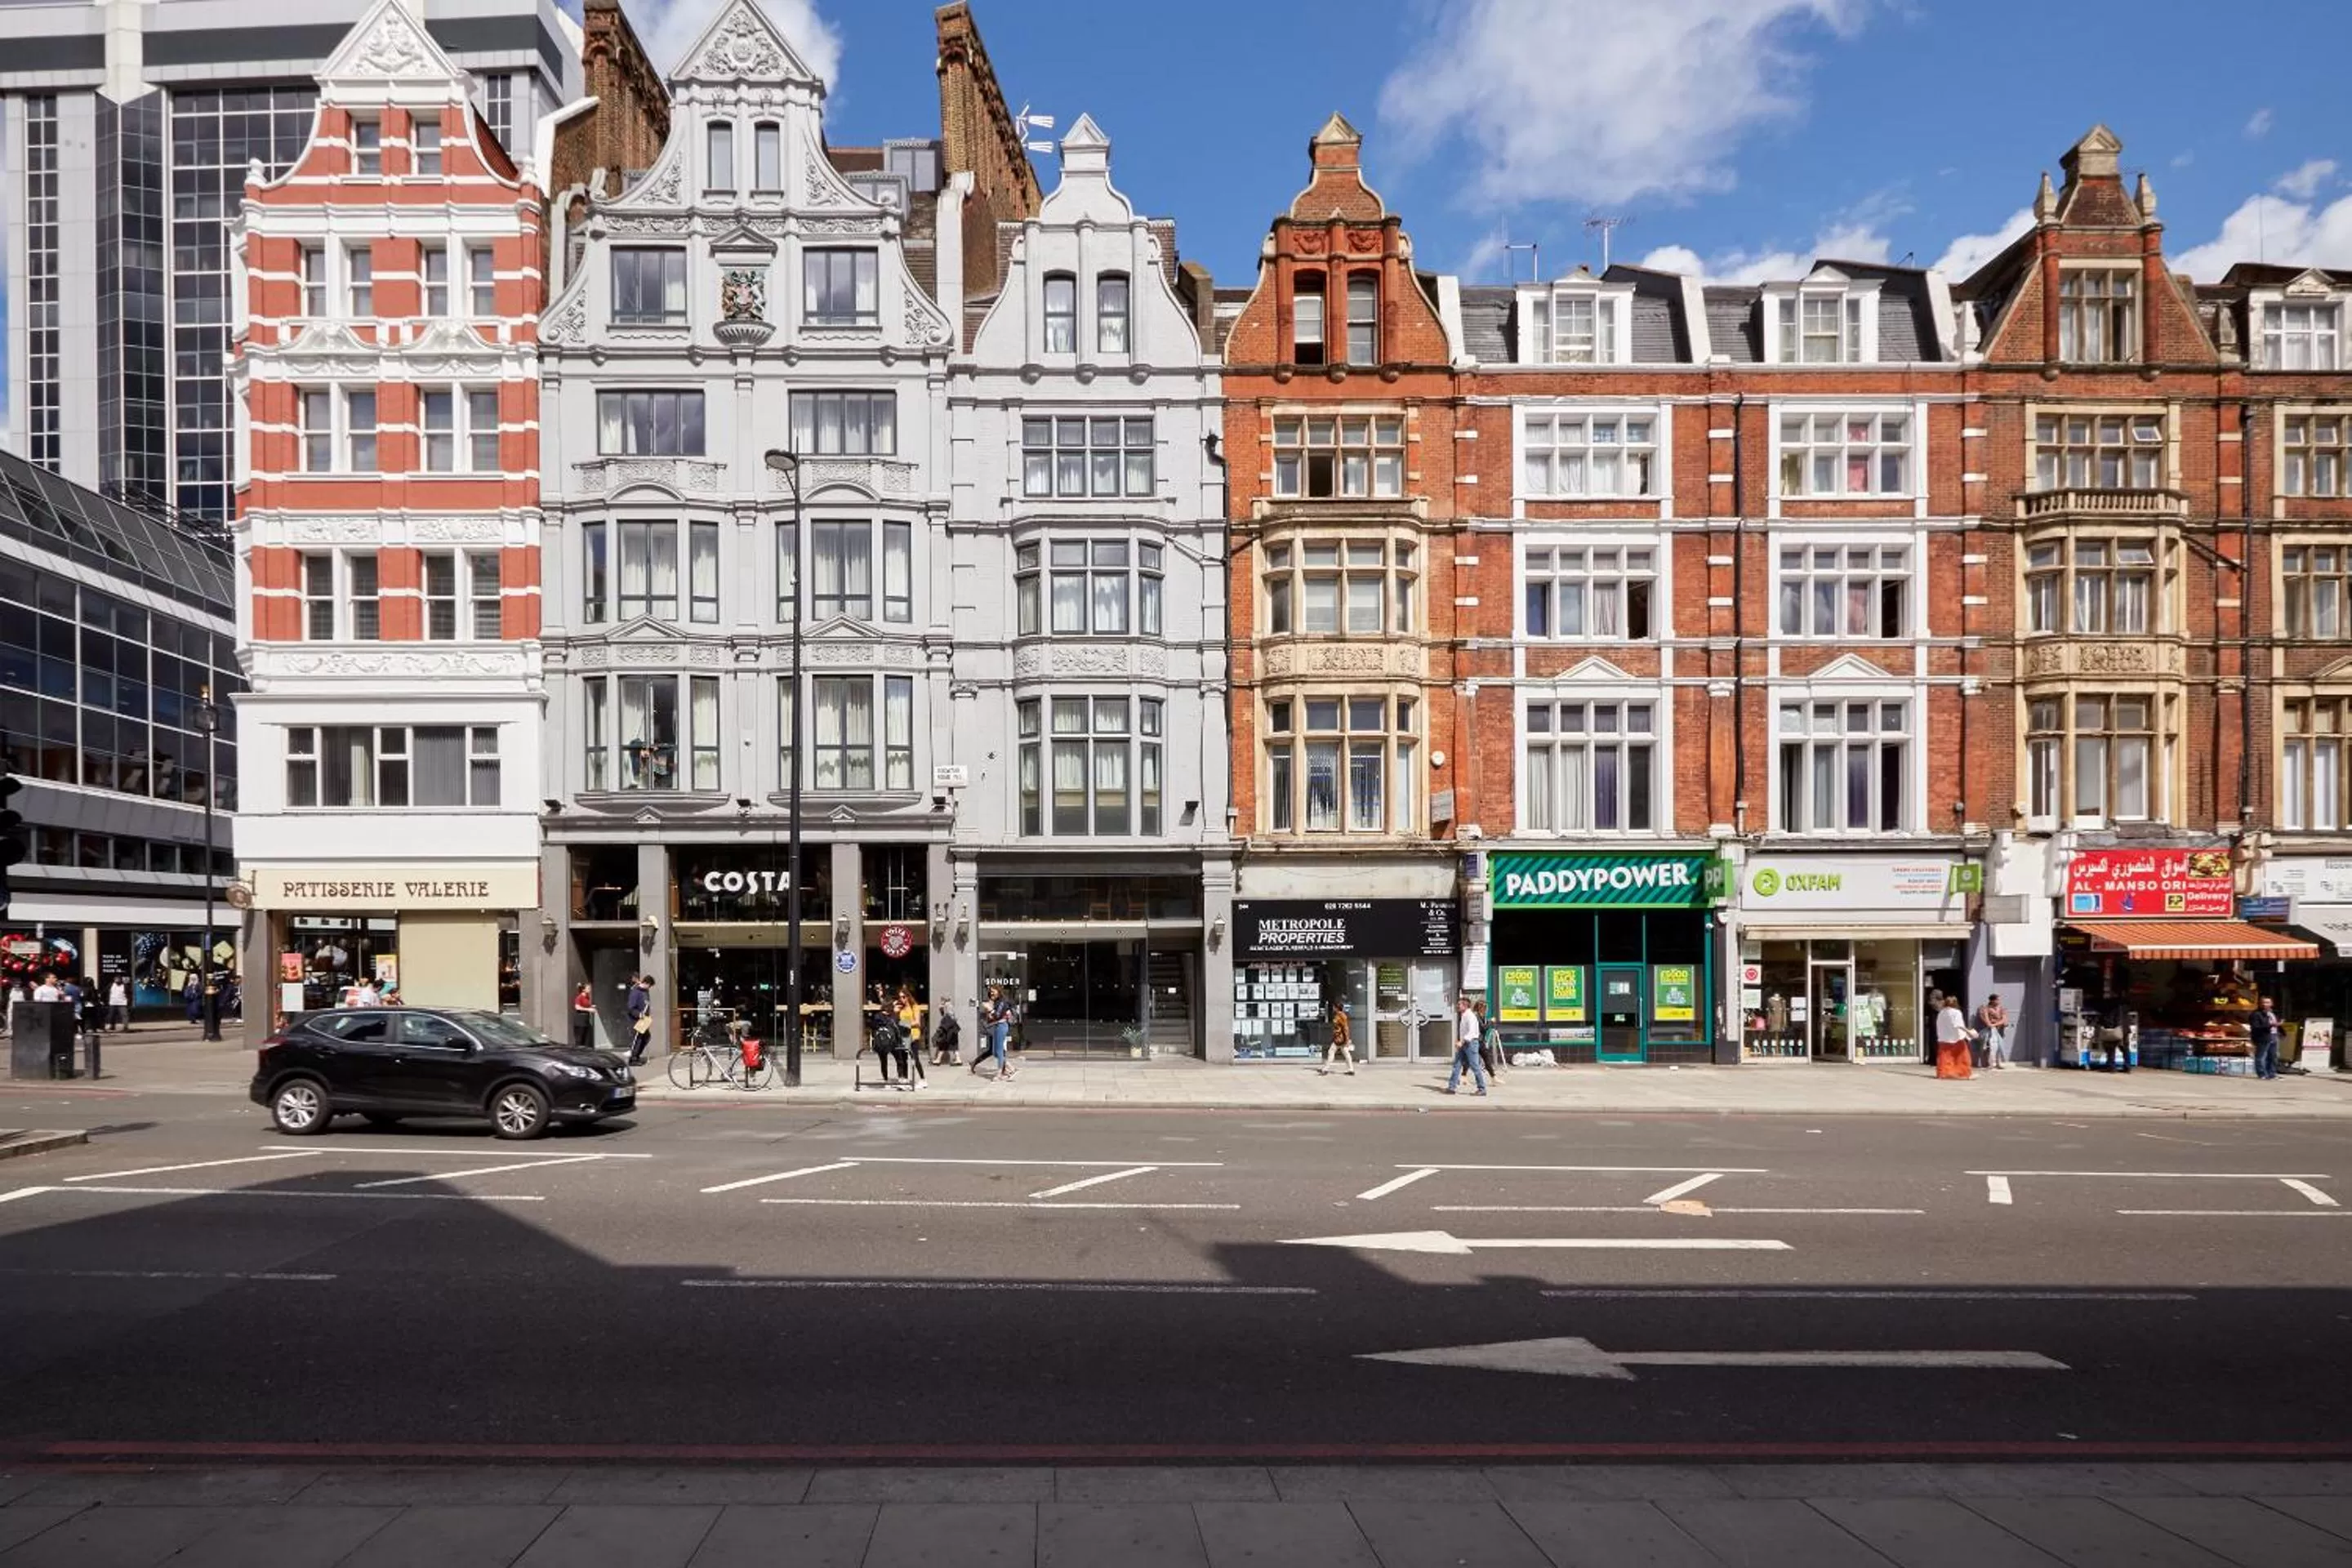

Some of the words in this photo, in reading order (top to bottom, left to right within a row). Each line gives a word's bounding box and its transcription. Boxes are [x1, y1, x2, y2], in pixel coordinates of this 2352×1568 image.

[1785, 875, 1841, 892] OXFAM
[2074, 882, 2092, 891] AL
[2105, 881, 2158, 891] MANSO
[2162, 881, 2186, 890] ORI
[283, 882, 396, 898] PATISSERIE
[405, 882, 490, 898] VALERIE
[2187, 892, 2229, 902] Delivery
[1258, 919, 1346, 930] METROPOLE
[1258, 933, 1345, 944] PROPERTIES
